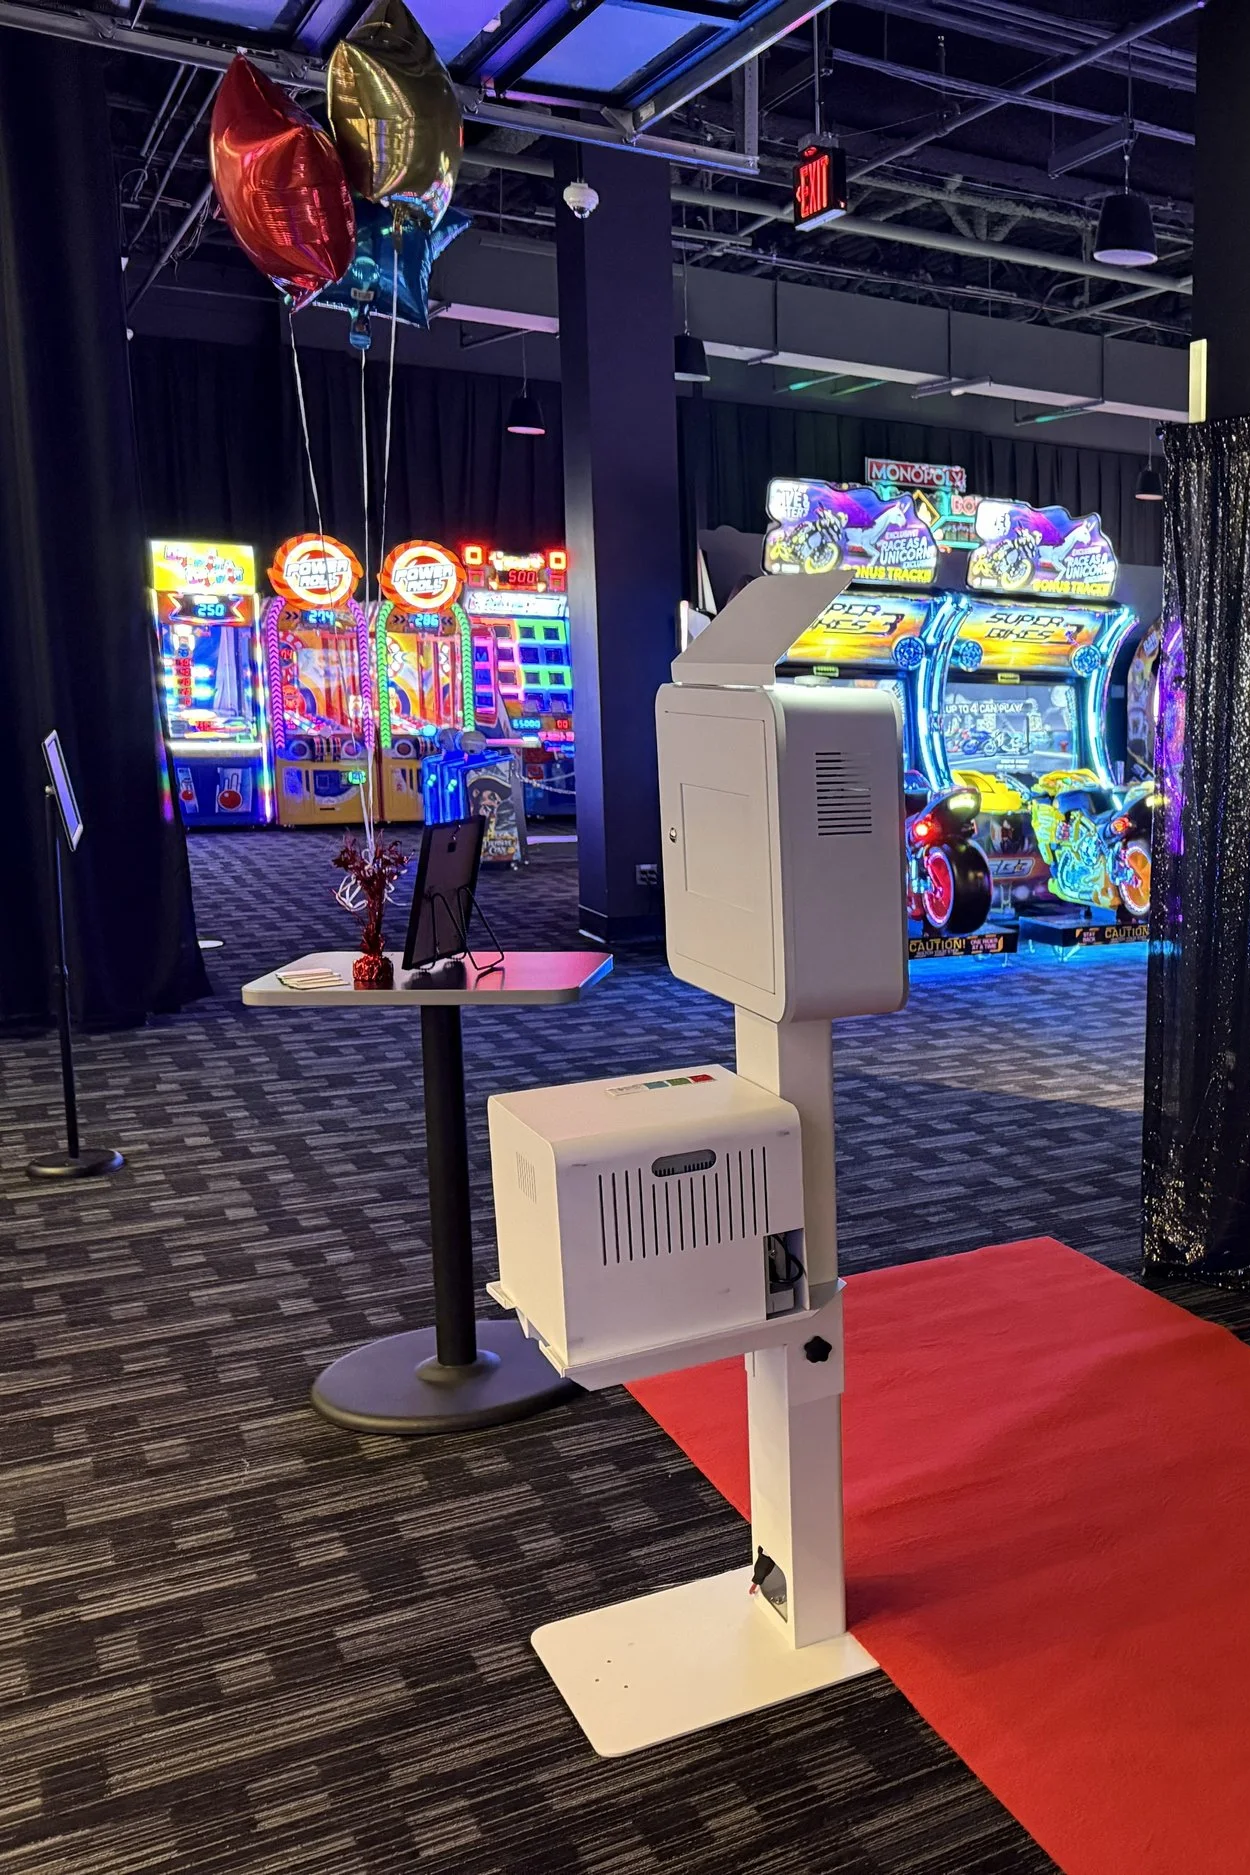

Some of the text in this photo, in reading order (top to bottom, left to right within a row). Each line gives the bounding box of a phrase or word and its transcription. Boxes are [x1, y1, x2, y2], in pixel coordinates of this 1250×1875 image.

[800, 154, 829, 218] EXIT
[871, 464, 964, 485] MONOPOLY
[878, 538, 906, 552] RACE
[907, 537, 919, 550] AS
[285, 559, 349, 577] POWER
[393, 564, 454, 582] POWER
[299, 574, 337, 588] ROLL
[508, 570, 536, 583] 500
[406, 578, 442, 593] ROLL
[197, 604, 225, 617] 250
[825, 602, 881, 616] PER
[985, 612, 1065, 627] SUPER
[984, 627, 1055, 641] BIKES
[945, 703, 958, 714] UP
[958, 703, 970, 714] TO
[970, 702, 979, 715] 4
[980, 703, 997, 714] CAN
[909, 938, 966, 953] CAUTION!
